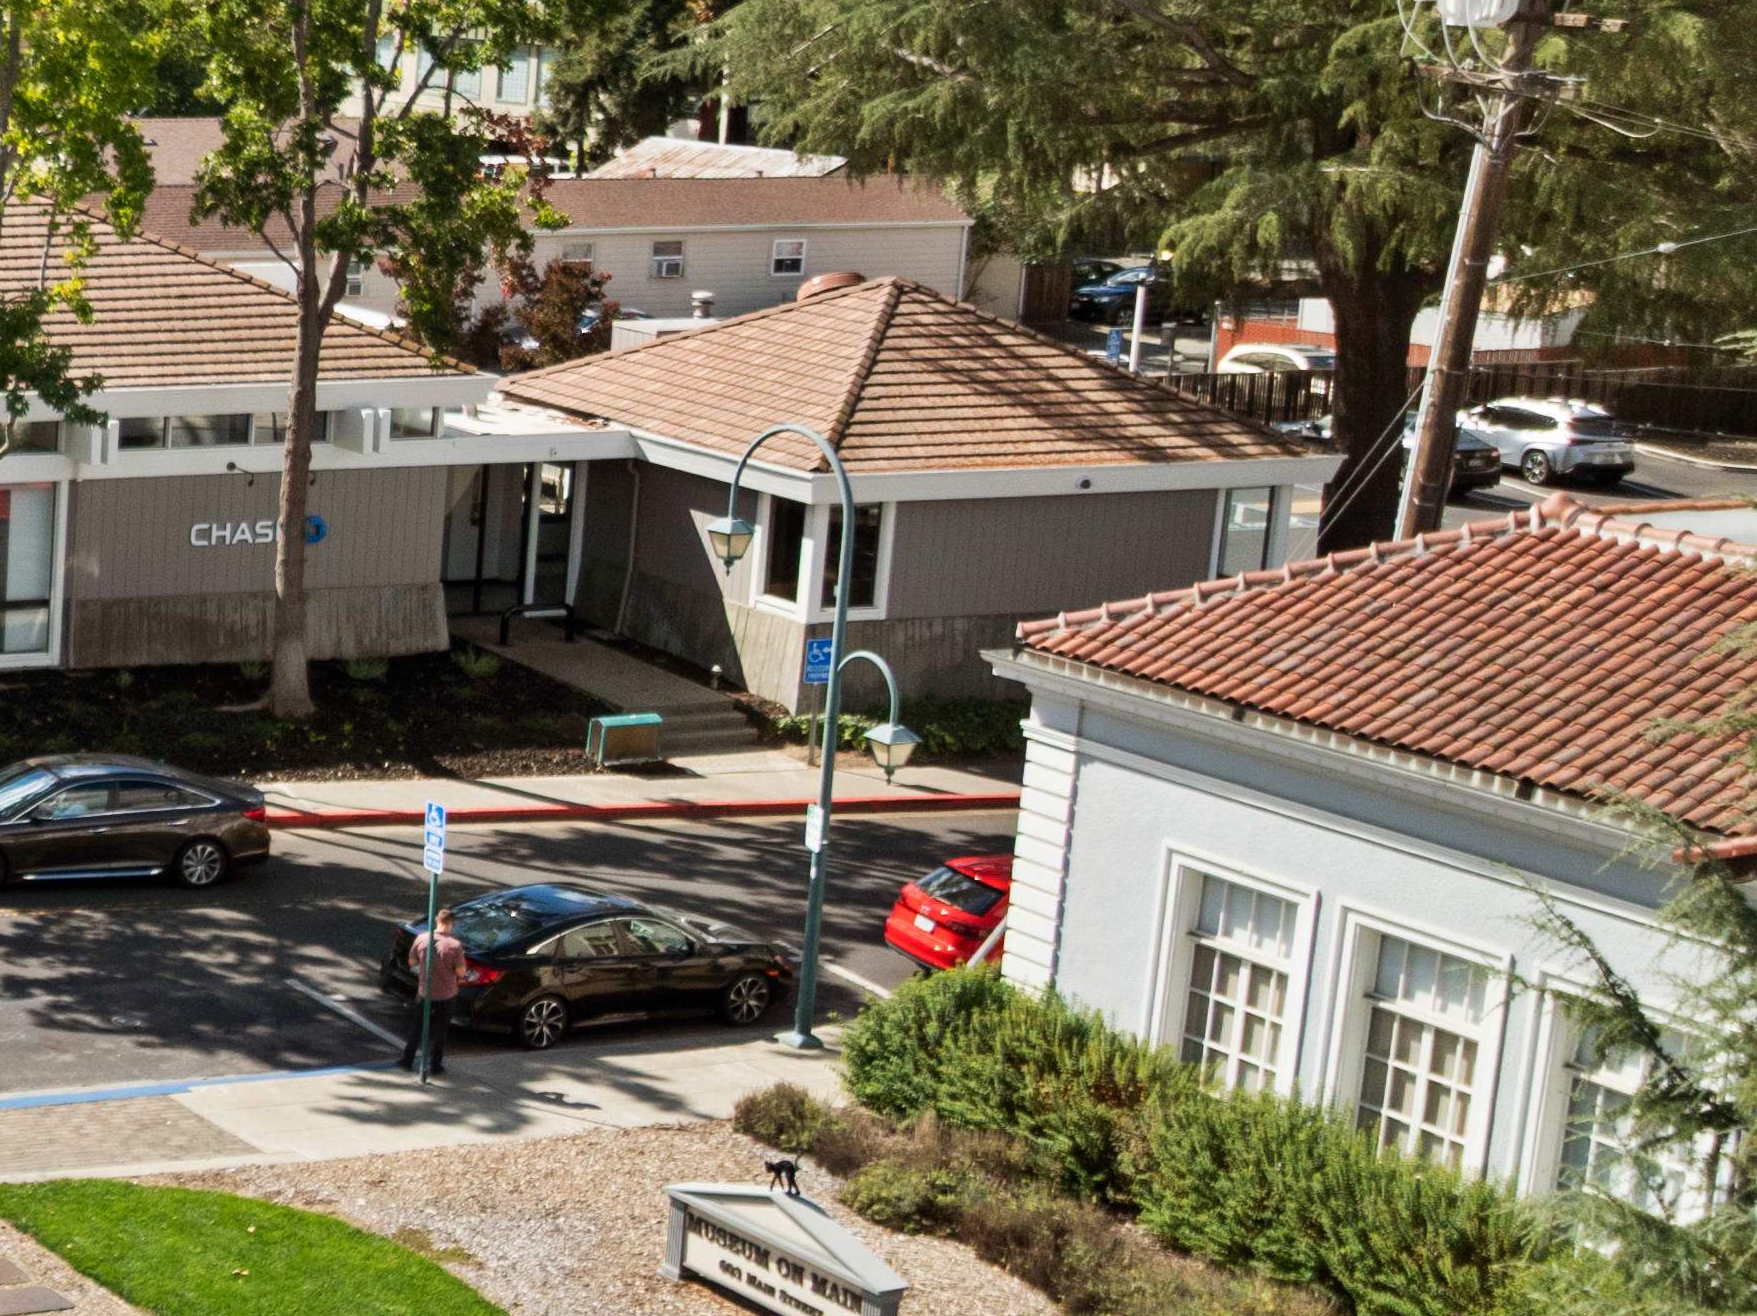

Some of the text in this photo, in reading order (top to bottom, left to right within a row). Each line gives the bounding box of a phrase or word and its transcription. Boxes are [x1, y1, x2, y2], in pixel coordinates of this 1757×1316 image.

[190, 520, 282, 546] CHAS
[687, 1211, 864, 1316] MUSEUM ON MAIN
